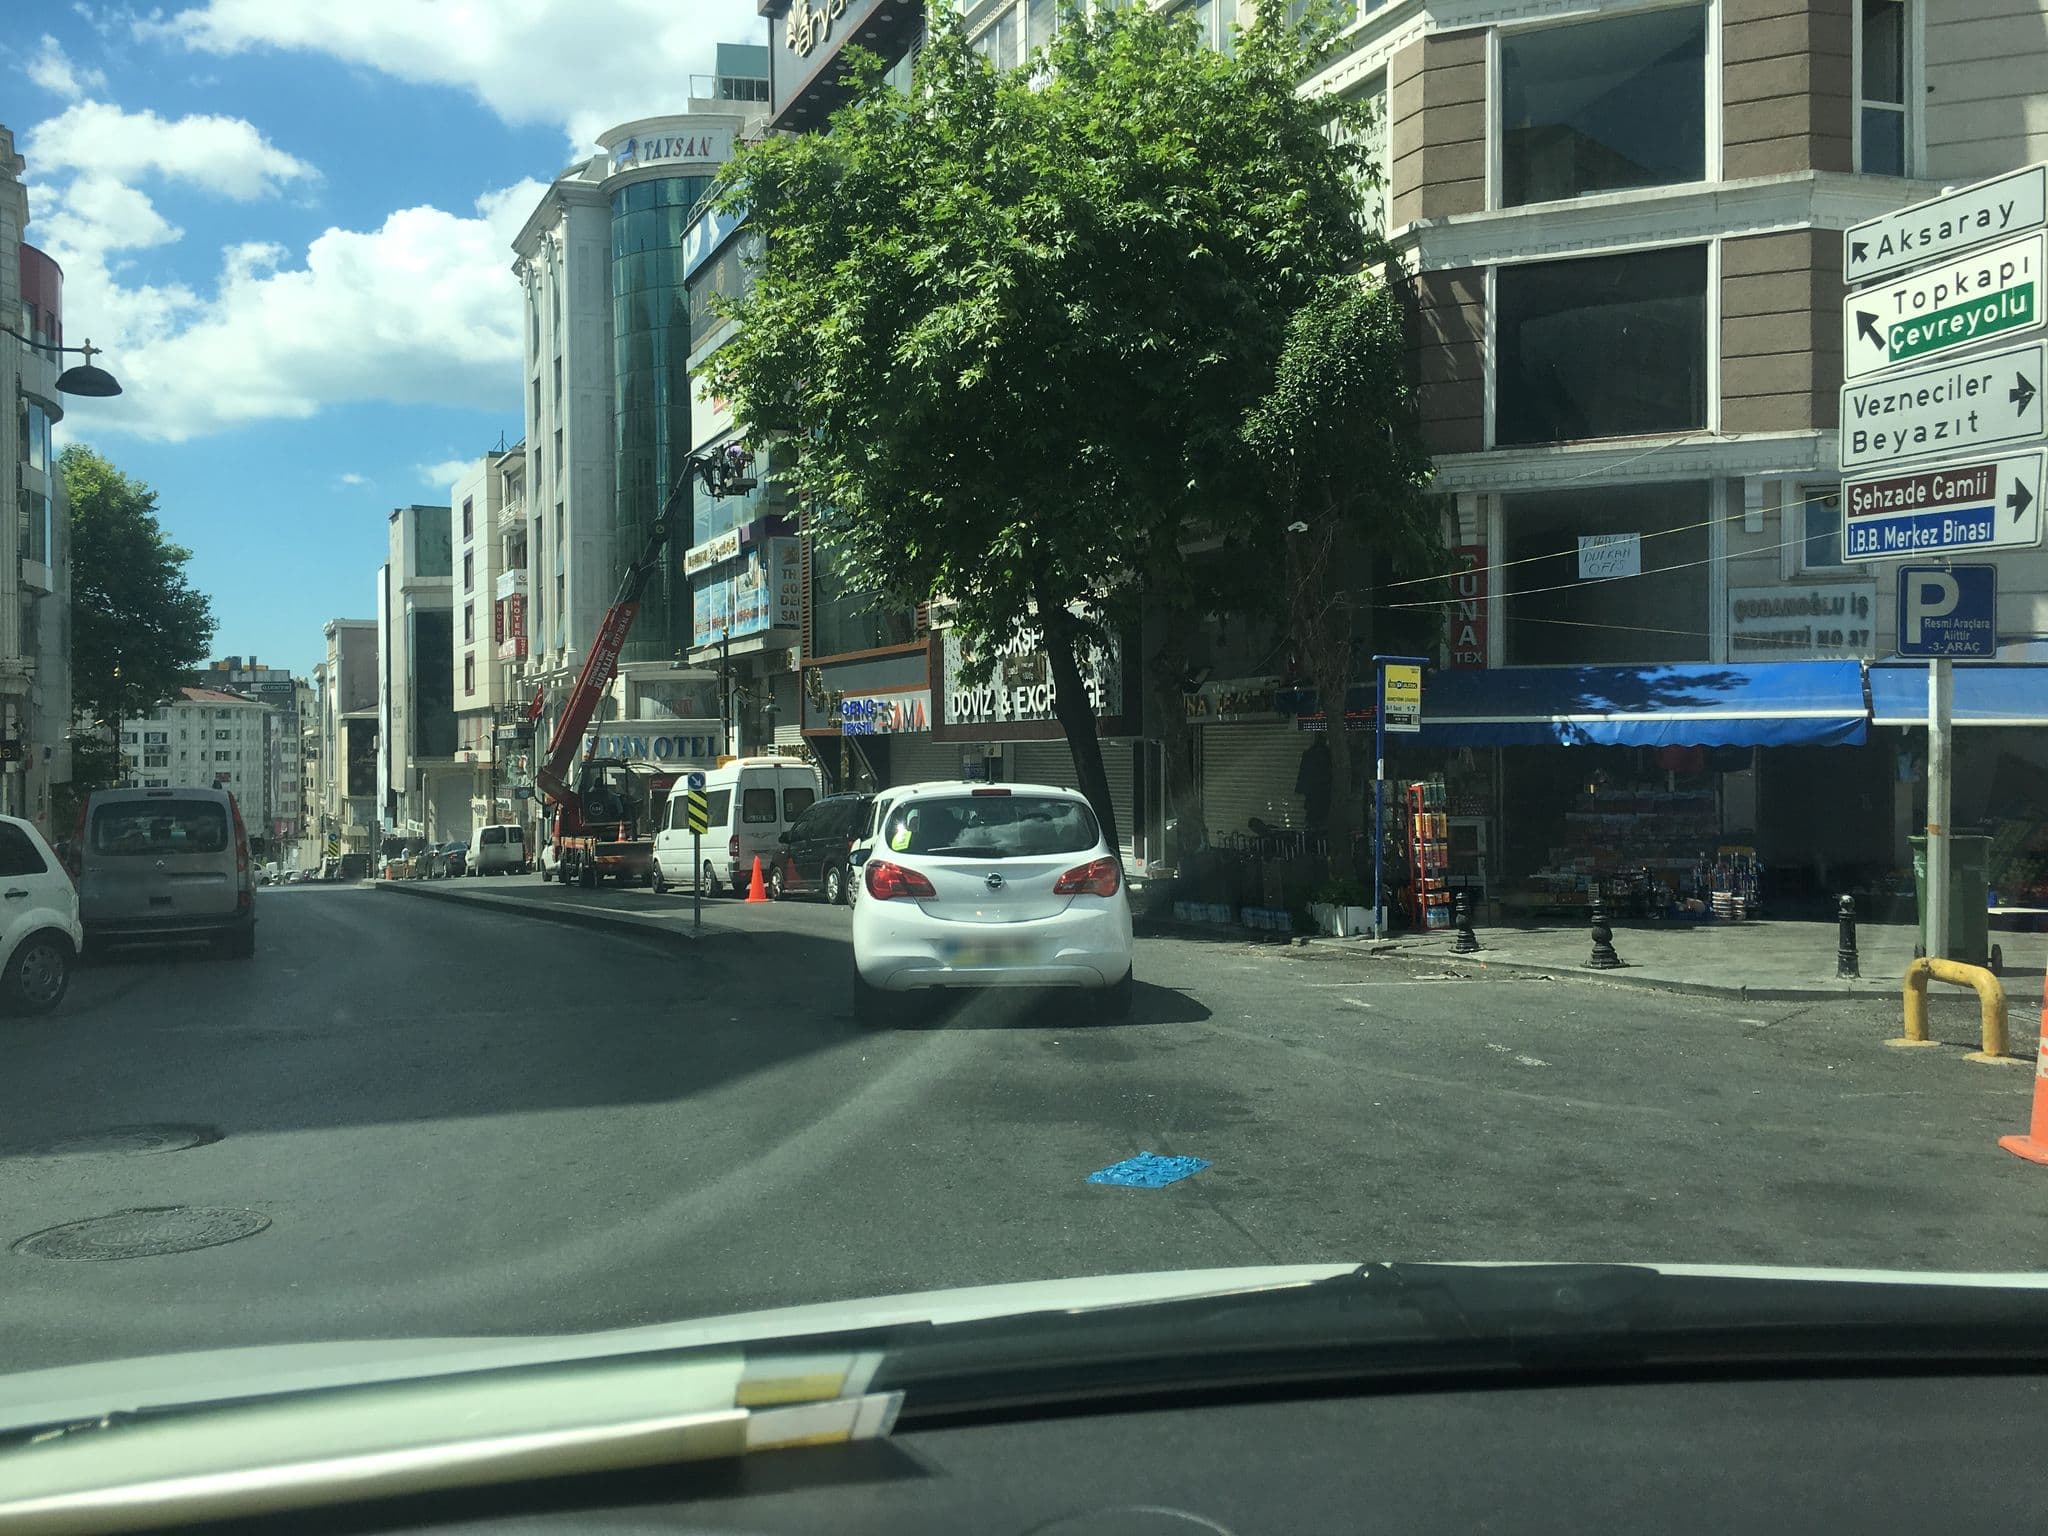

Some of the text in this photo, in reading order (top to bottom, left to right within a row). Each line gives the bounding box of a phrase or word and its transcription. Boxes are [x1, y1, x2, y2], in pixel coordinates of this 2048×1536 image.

[644, 136, 713, 161] TAYSAN
[1877, 200, 2014, 259] Aksaray
[1893, 257, 2028, 314] Topkapı
[1890, 294, 2028, 354] Çevreyolu
[1854, 374, 1993, 418] Vezneciler
[1853, 410, 1978, 454] Beyazıt
[1853, 471, 1988, 514] Şehzade Camii
[1884, 526, 1938, 547] Merkez
[1943, 519, 1991, 543] Binası
[513, 600, 521, 636] NOTER
[1906, 571, 1960, 644] P
[1455, 652, 1482, 663] TEX
[1946, 642, 1981, 653] ARAÇ
[1001, 691, 1011, 714] &
[653, 736, 721, 758] OTEL
